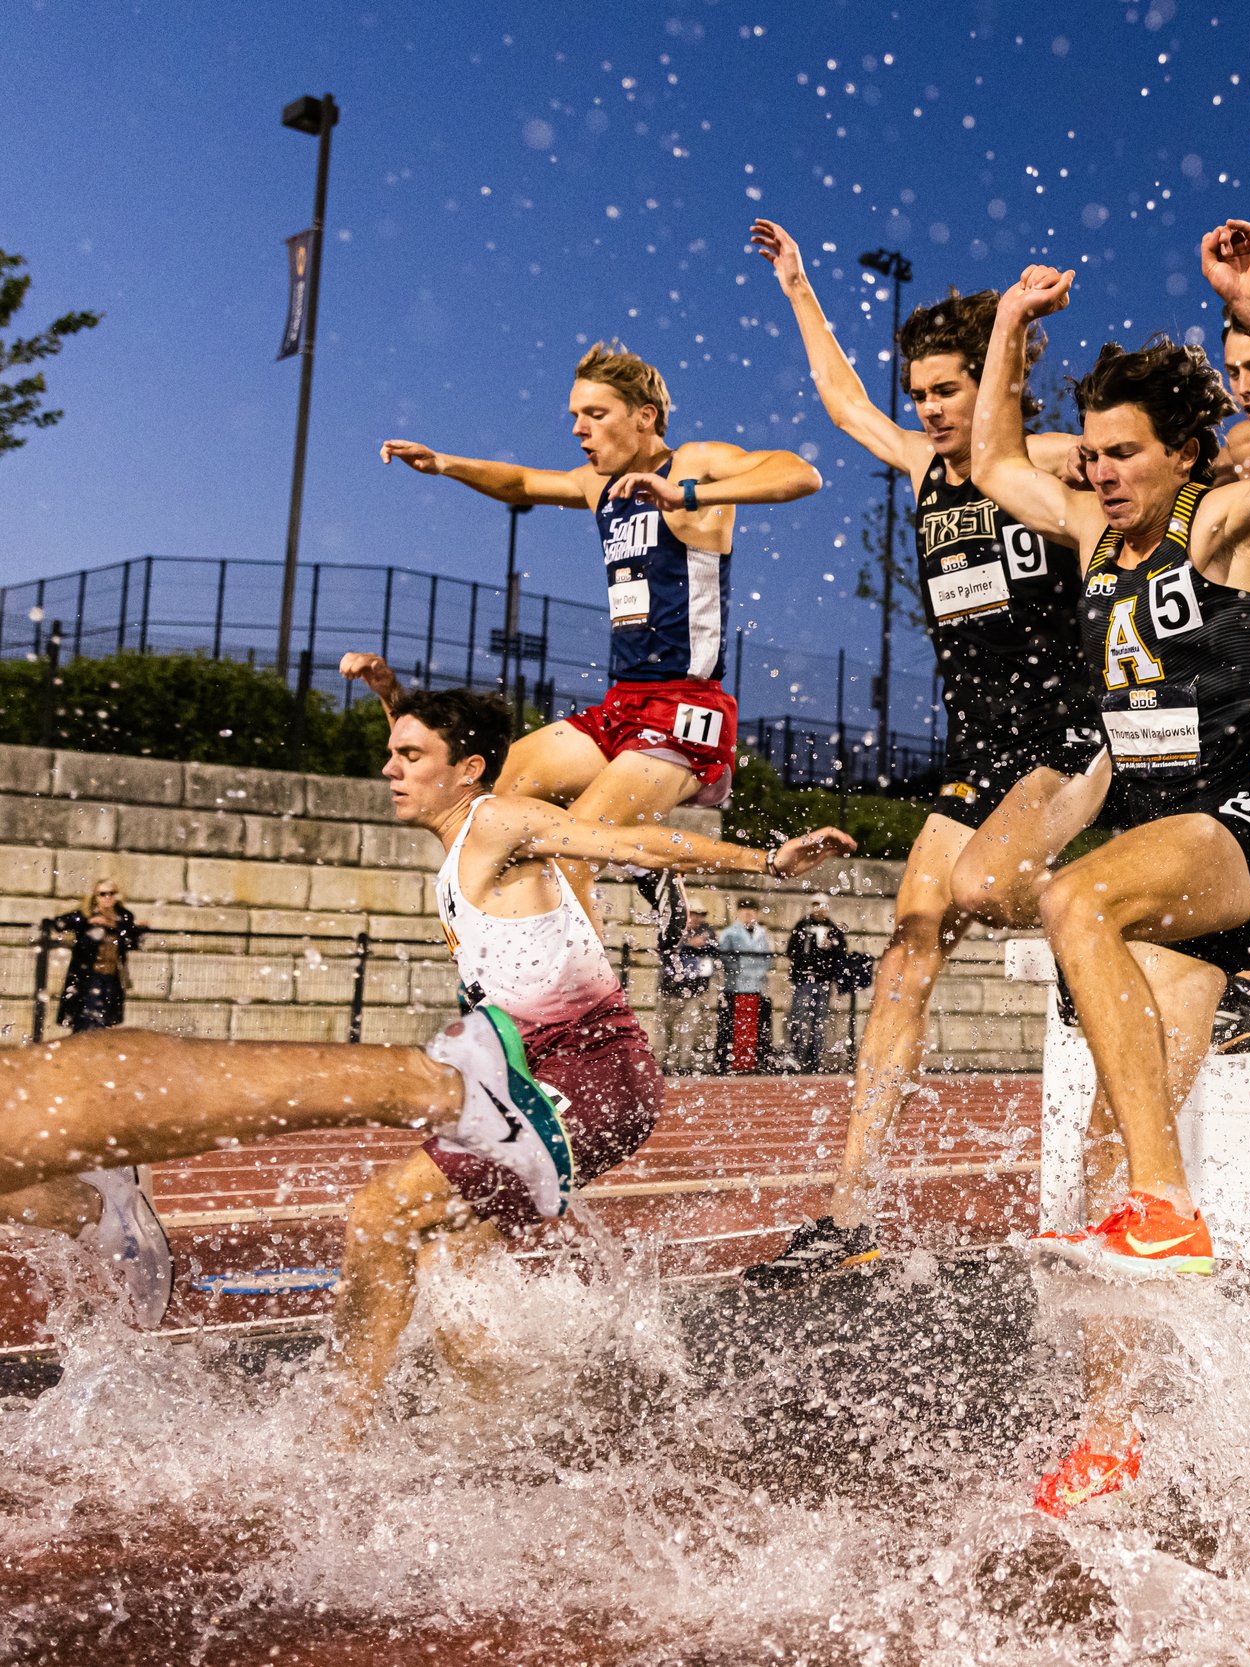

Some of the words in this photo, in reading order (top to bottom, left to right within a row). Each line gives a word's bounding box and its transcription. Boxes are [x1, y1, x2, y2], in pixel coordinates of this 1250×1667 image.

[630, 514, 648, 547] 11
[924, 499, 998, 556] TXST
[941, 552, 969, 573] SBC
[1011, 527, 1042, 573] 9
[957, 580, 993, 597] Palmer
[1155, 573, 1191, 630] 5
[1103, 595, 1165, 691] A
[1129, 689, 1158, 709] SBC
[682, 708, 713, 742] 11
[1108, 728, 1141, 740] Thomas
